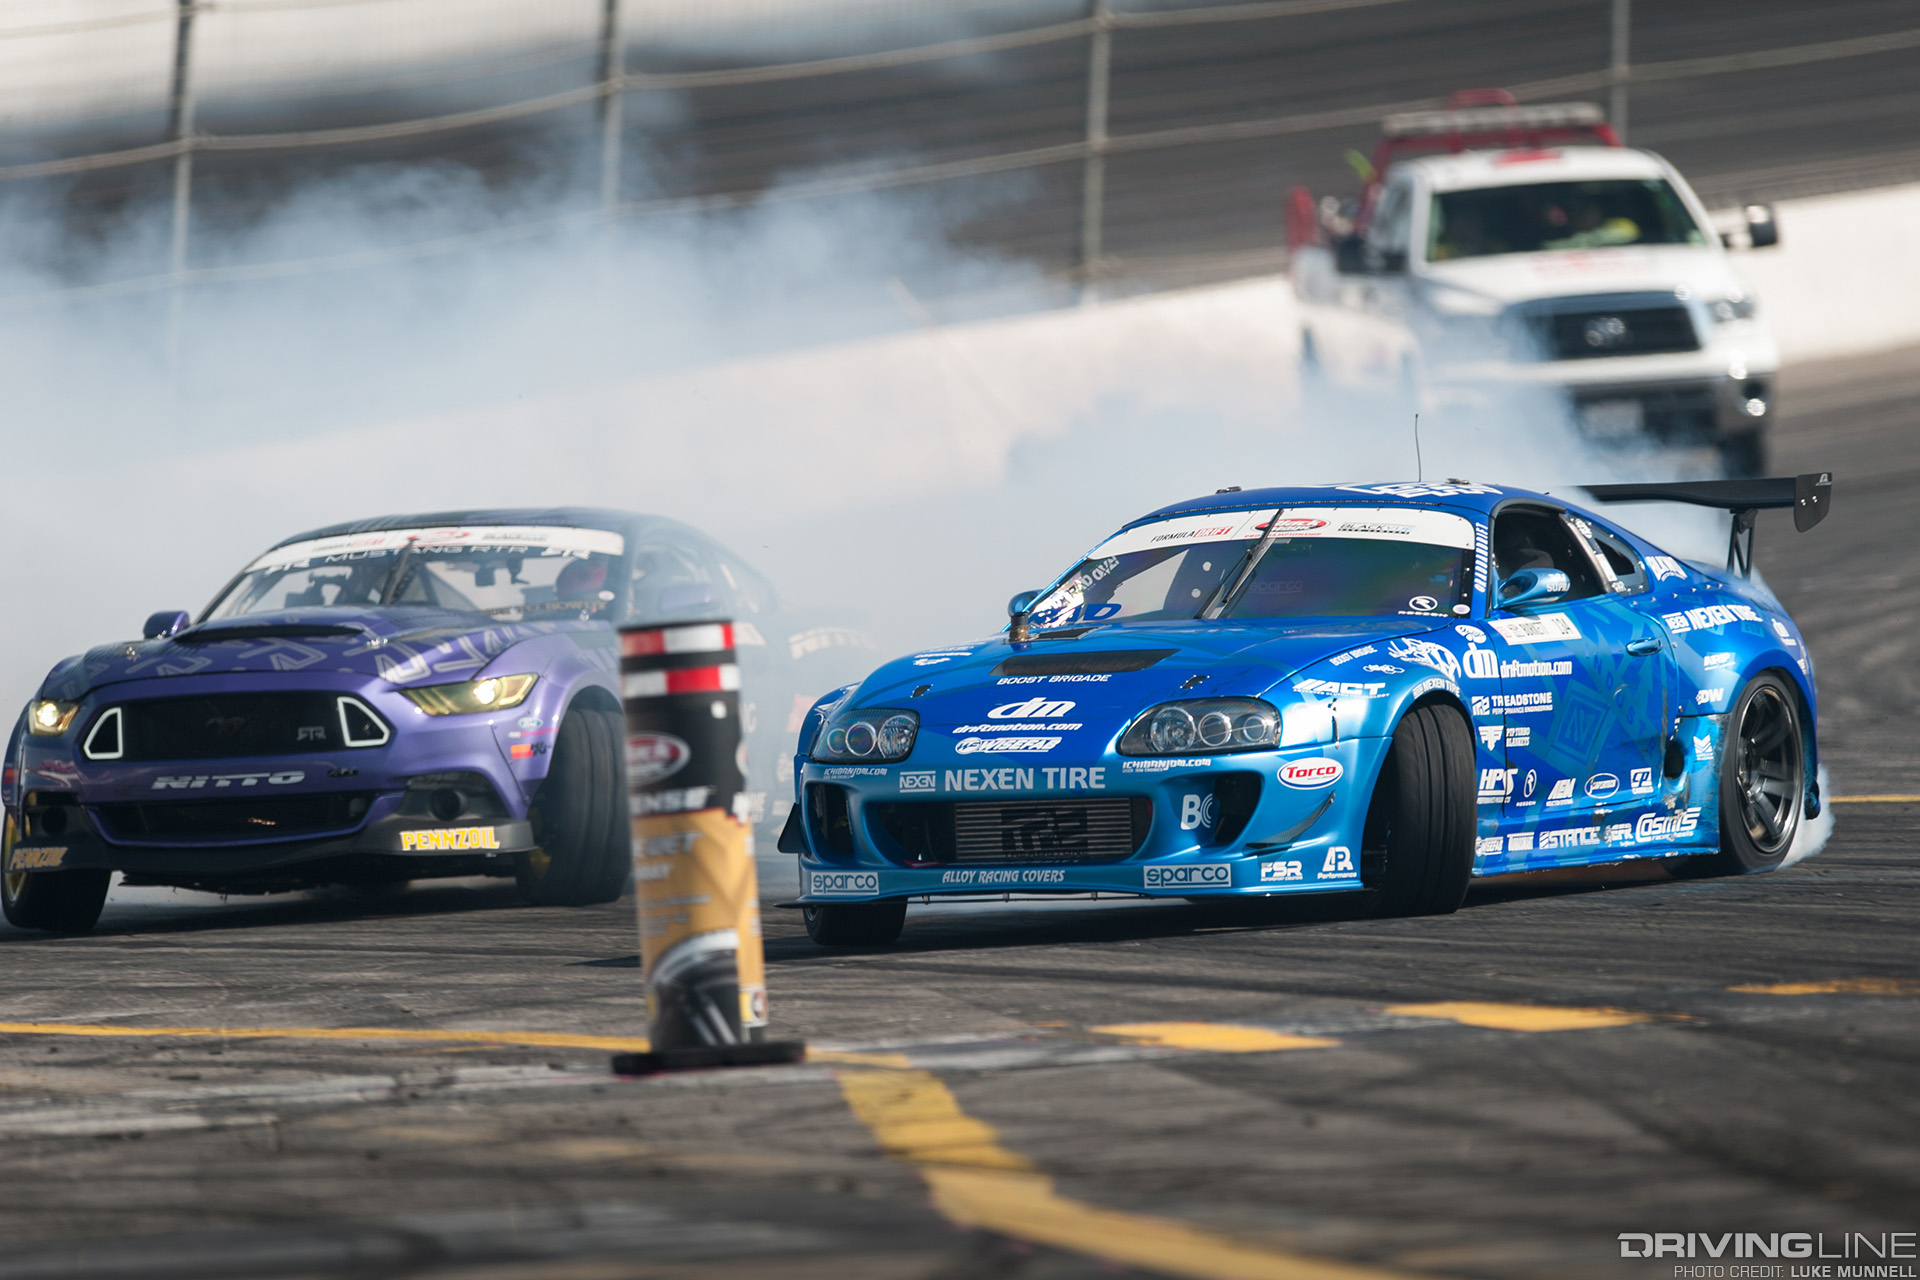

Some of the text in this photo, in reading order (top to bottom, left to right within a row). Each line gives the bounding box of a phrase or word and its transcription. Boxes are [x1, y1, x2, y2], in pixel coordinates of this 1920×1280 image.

[1151, 526, 1234, 543] FORMULA DRIFT
[325, 545, 528, 563] MUSTANG RTR
[1684, 606, 1738, 630] NEXEN
[1463, 641, 1500, 678] dm
[1500, 660, 1573, 678] driftmotion.com
[997, 673, 1112, 685] BOOST BRIGADE
[1309, 680, 1386, 696] ACT
[987, 697, 1076, 719] dm
[1491, 692, 1553, 707] TREADSTONE
[952, 722, 1083, 733] driftmotion.com
[980, 737, 1062, 752] WISEFAB
[152, 770, 305, 790] NITTO
[900, 771, 936, 793] NEXEN
[945, 767, 1106, 792] NEXEN TIRE
[1286, 765, 1337, 779] Torco
[1479, 768, 1519, 795] HPS
[1547, 777, 1577, 800] AEM
[400, 826, 500, 851] PENNZOIL
[1548, 827, 1601, 849] STANCE
[10, 847, 68, 870] PENNZOIL
[942, 870, 1065, 884] ALLOY RACING COVERS
[1146, 865, 1230, 887] sparco
[1261, 861, 1302, 877] FSR
[1317, 872, 1357, 880] Performance
[813, 874, 877, 894] sparco
